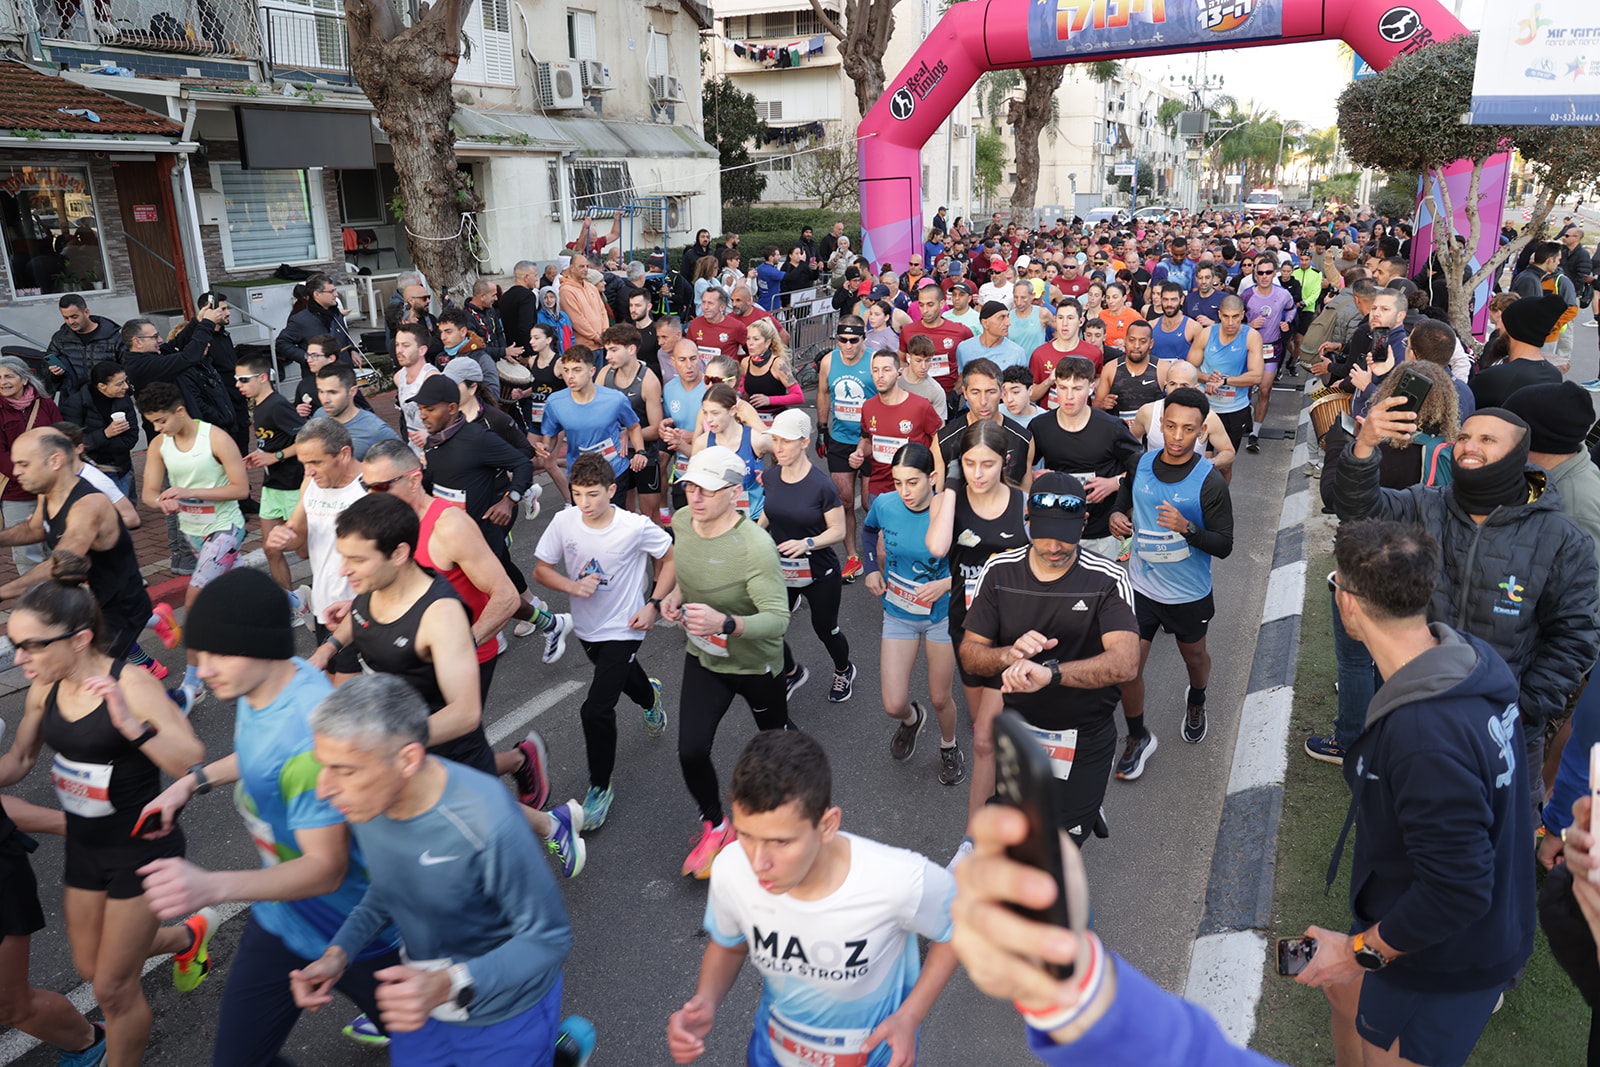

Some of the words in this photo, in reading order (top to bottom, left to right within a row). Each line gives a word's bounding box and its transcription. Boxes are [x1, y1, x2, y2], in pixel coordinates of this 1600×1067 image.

[906, 60, 928, 92] Real
[912, 59, 949, 98] Timing
[1155, 544, 1167, 552] 30
[899, 589, 918, 602] 1387
[753, 925, 869, 968] MAOZ
[799, 962, 869, 981] STRONG
